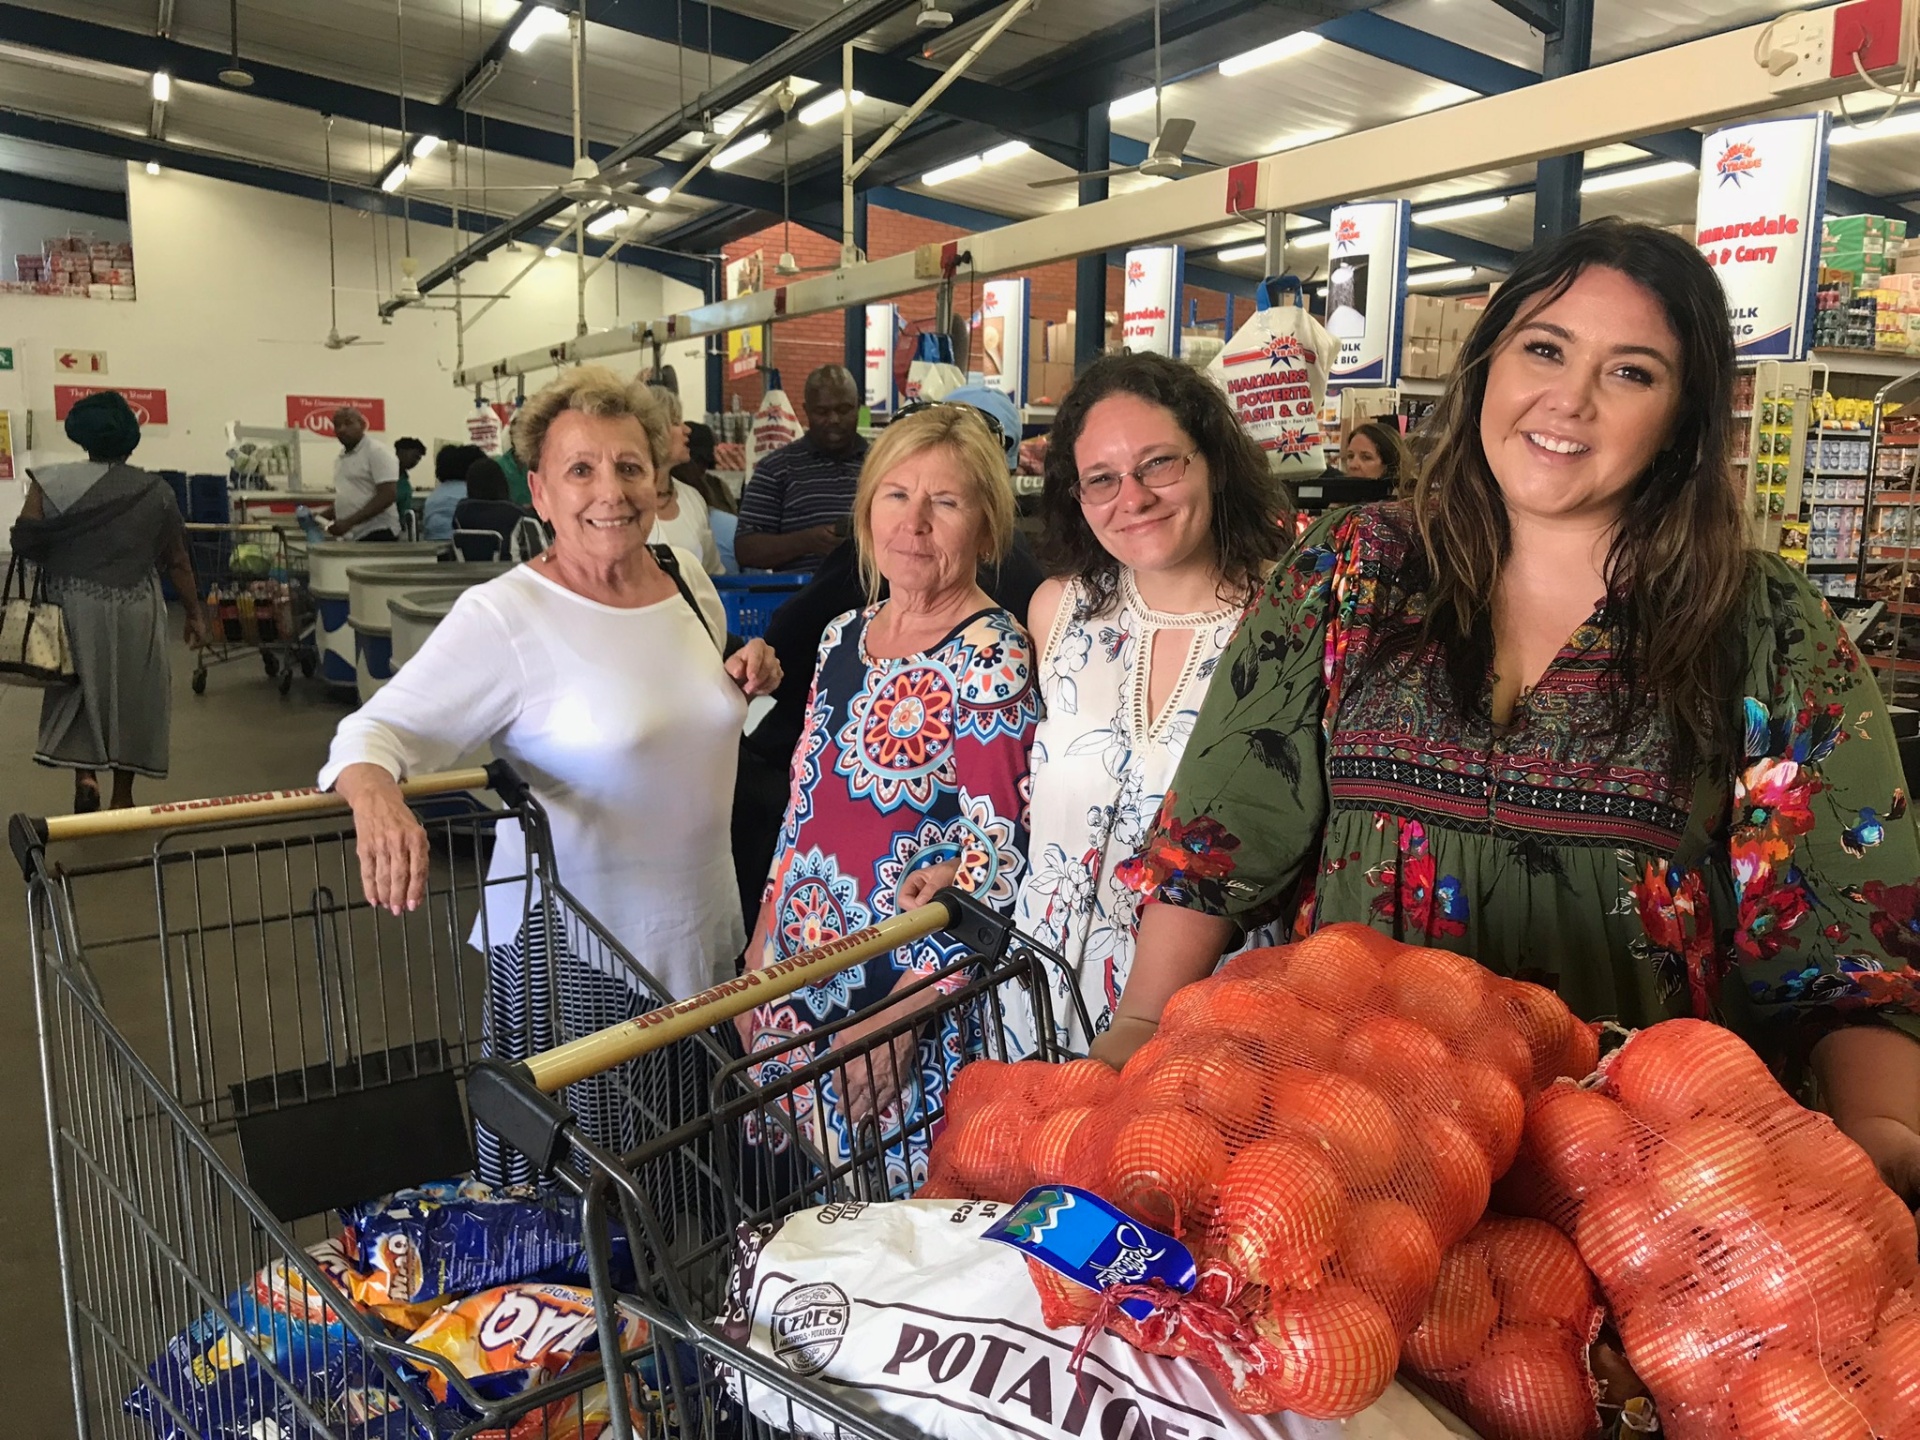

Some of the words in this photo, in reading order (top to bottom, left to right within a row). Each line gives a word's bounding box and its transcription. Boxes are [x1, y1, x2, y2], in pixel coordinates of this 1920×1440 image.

[1726, 158, 1762, 173] TRADE
[1735, 245, 1778, 264] Carry
[1728, 307, 1759, 319] ULK
[1263, 335, 1298, 356] POWER
[1341, 343, 1361, 352] ULK
[1341, 356, 1359, 364] BIG
[1227, 369, 1308, 394] HAMMARS
[1236, 385, 1311, 409] POWERTR
[1279, 404, 1293, 418] &
[1283, 442, 1312, 453] CARRY
[763, 926, 882, 980] HAMMARSDALE
[633, 972, 761, 1030] POWERTRADE
[778, 1308, 843, 1336] CERES
[810, 1327, 837, 1339] POTATOES
[882, 1322, 1217, 1440] POTATOE
